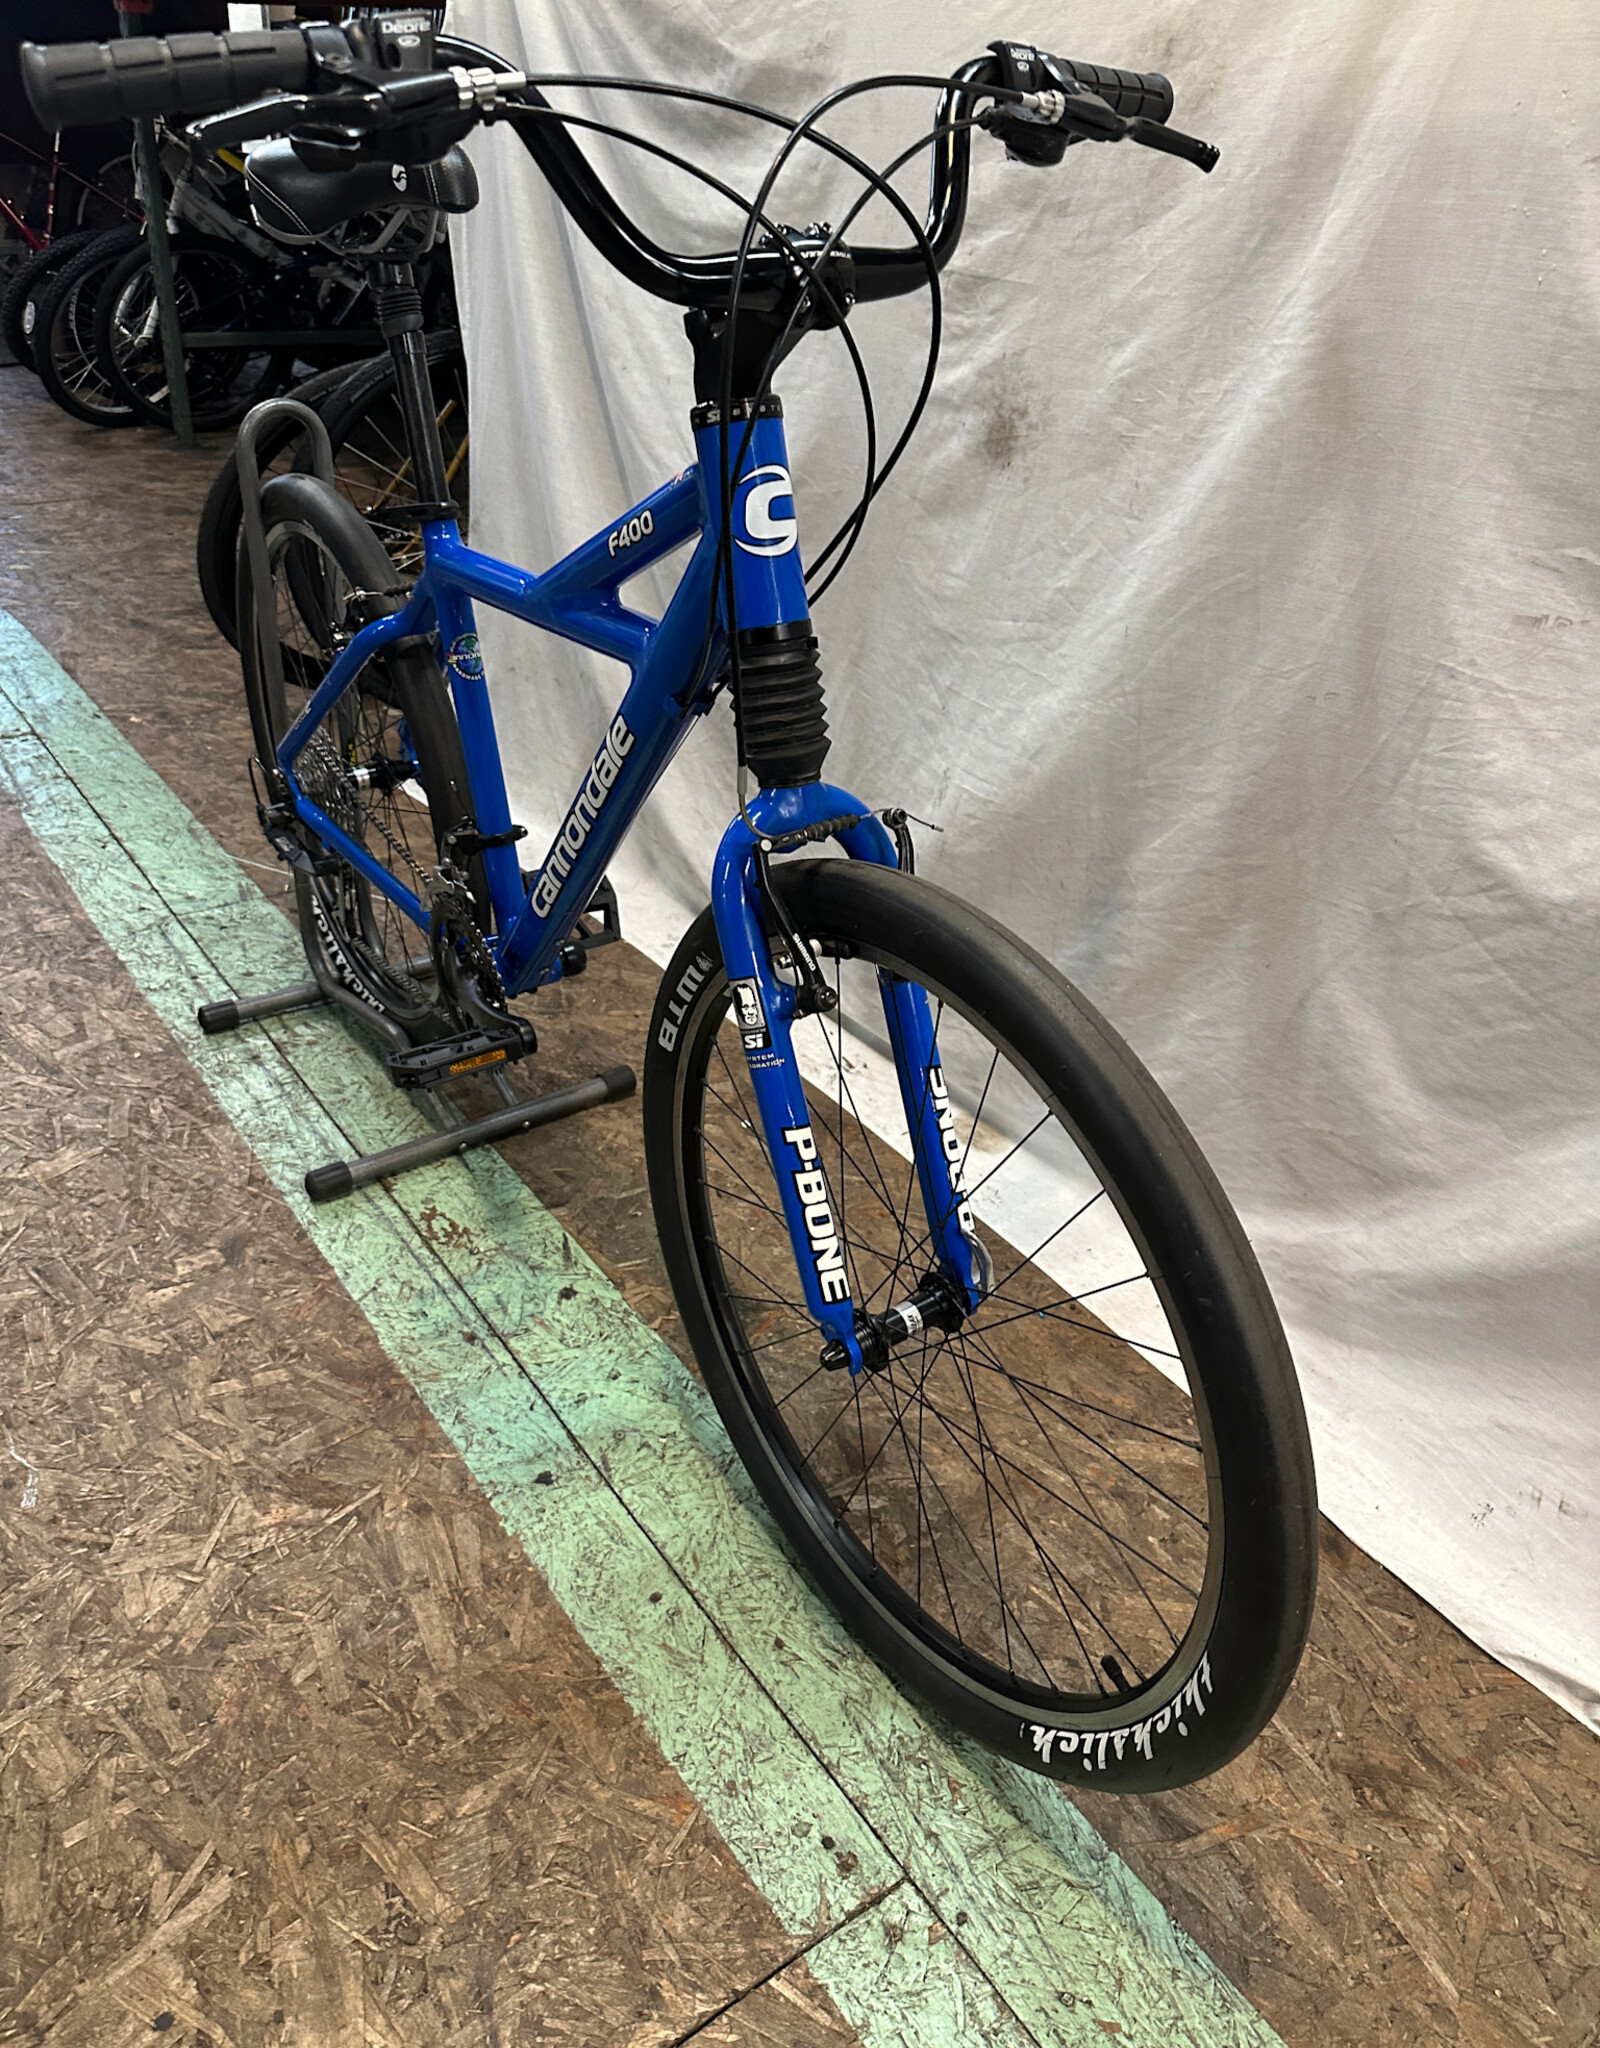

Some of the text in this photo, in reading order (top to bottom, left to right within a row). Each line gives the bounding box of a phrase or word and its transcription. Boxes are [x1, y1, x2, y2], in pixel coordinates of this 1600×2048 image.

[382, 21, 431, 34] Deore
[607, 509, 654, 557] F400
[531, 714, 636, 918] cannondale
[792, 932, 816, 971] SHIMANO
[658, 964, 706, 1052] WTB
[744, 1033, 764, 1049] Si
[784, 1126, 852, 1303] P-BONE
[1029, 1650, 1214, 1770] thickslick
